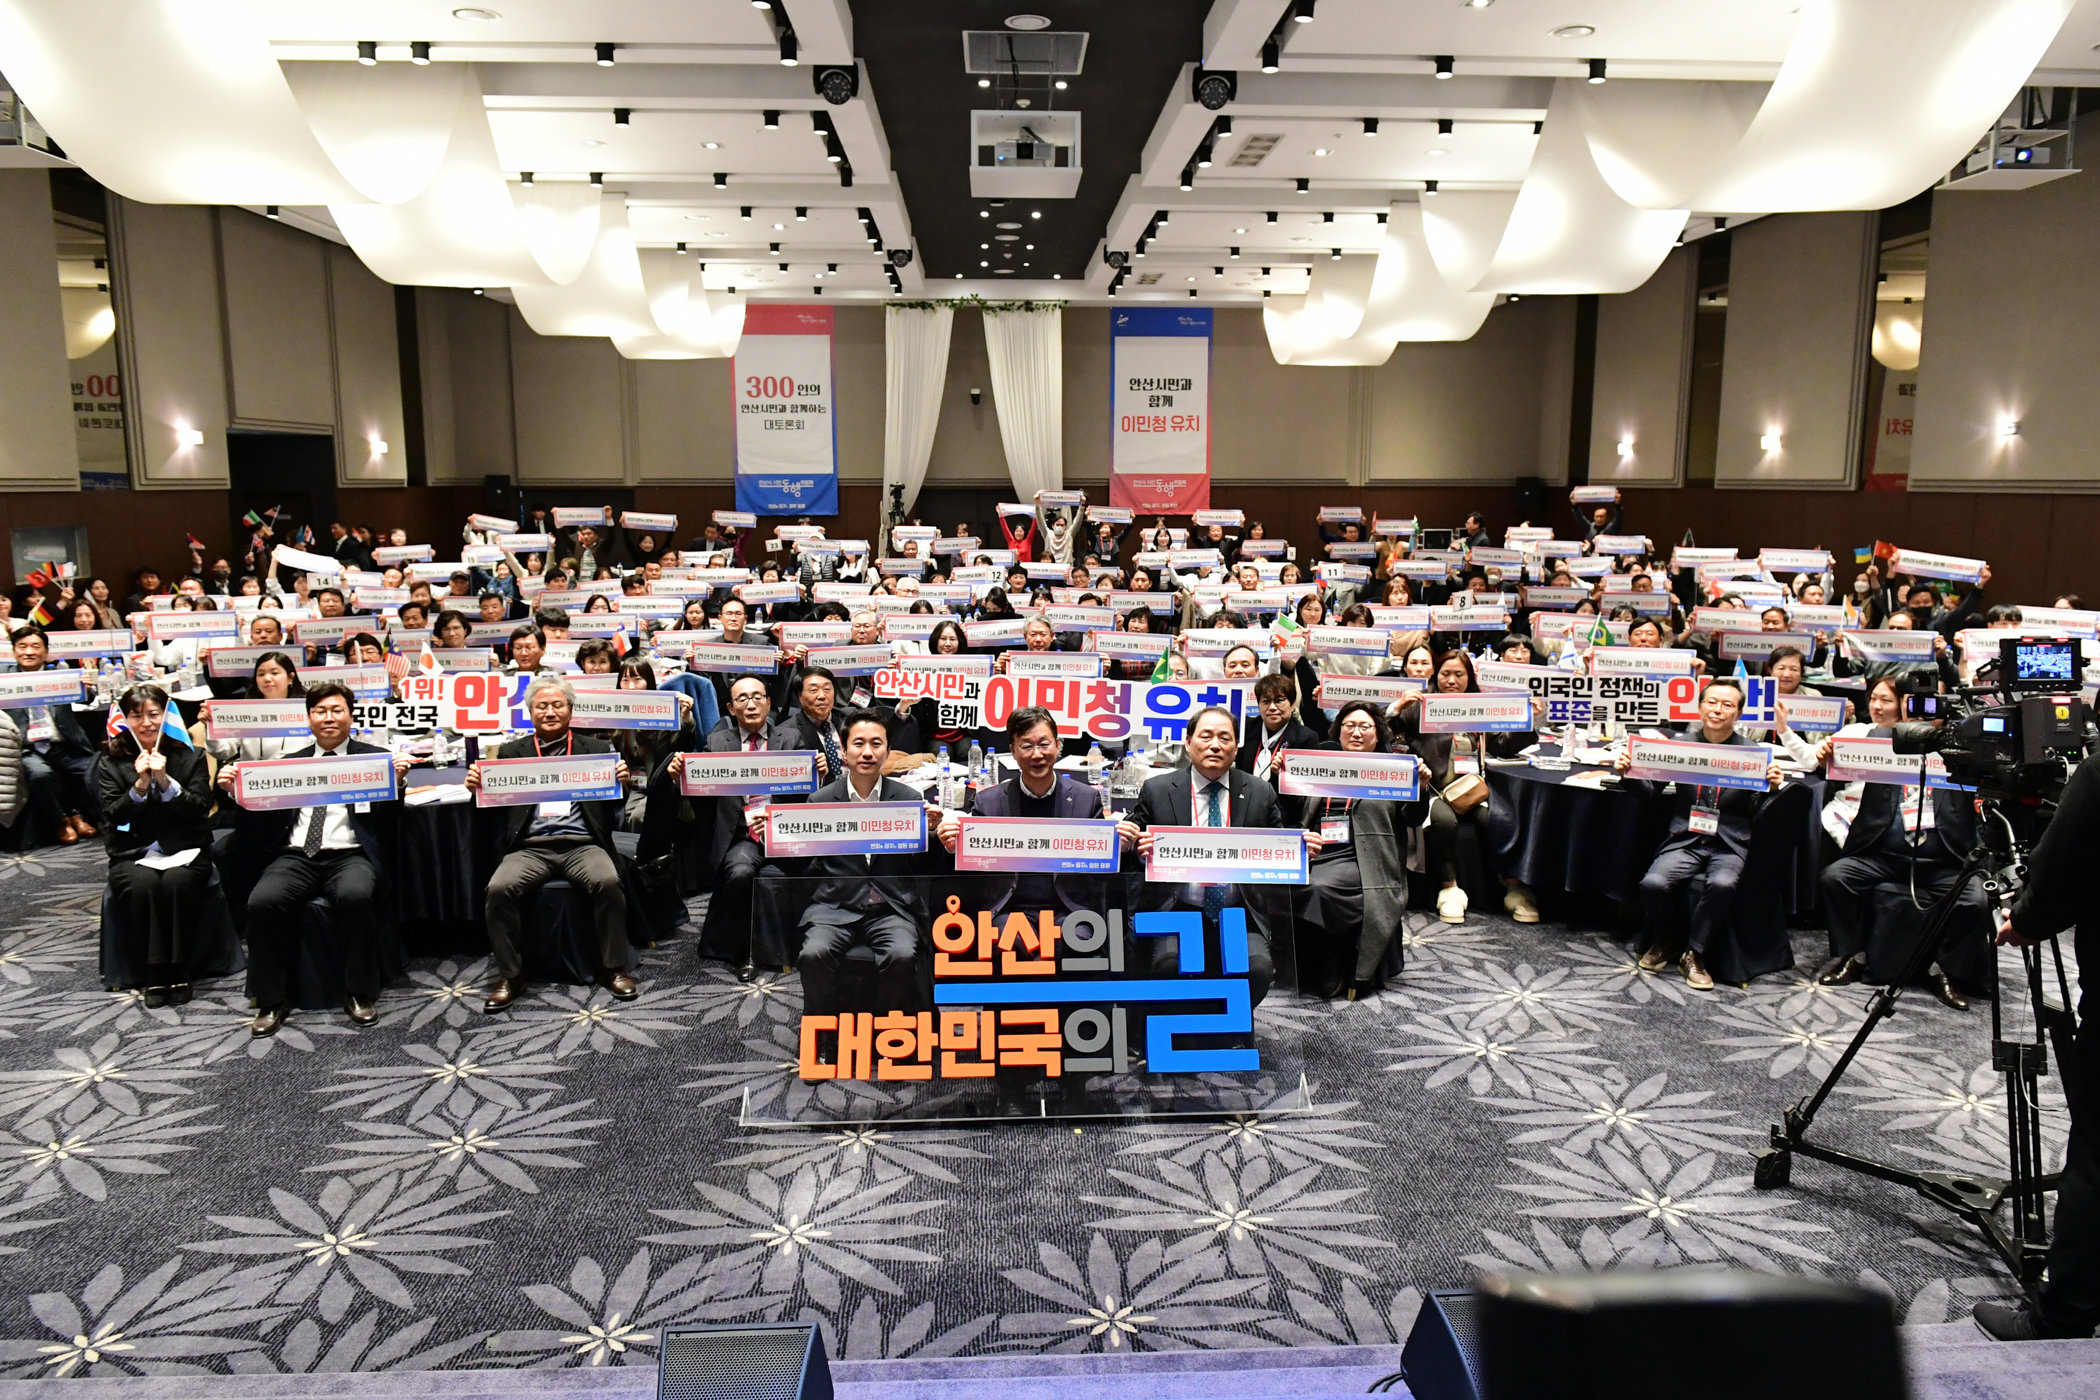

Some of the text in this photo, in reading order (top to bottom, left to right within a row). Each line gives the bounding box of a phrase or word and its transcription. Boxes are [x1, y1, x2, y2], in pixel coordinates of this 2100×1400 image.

[746, 376, 820, 398] 300 인의
[1129, 378, 1192, 391] 안산시민과
[1148, 394, 1173, 408] 함께
[741, 404, 826, 414] 안산시민과 함께하는
[764, 419, 804, 430] 대토론회
[1122, 415, 1200, 432] 이민청 유치
[316, 578, 329, 586] 14
[992, 571, 1001, 579] 12
[1460, 596, 1466, 608] 8
[401, 678, 444, 700] 1위!
[876, 671, 980, 700] 안산시민과
[1327, 687, 1362, 695] 안산시민과
[1381, 689, 1402, 697] 이민청
[1529, 677, 1660, 699] 외국인 정책의
[574, 704, 612, 712] 안산시민과
[633, 704, 654, 713] 이민청
[656, 705, 670, 713] 유치
[984, 677, 1132, 737] 이민청
[1549, 700, 1659, 722] 표준을 만든
[217, 712, 304, 723] 안산시민과 함께 이민청
[352, 706, 438, 728] 국인 전국
[940, 704, 978, 727] 함께
[1637, 752, 1761, 773] 안산시민과 함께 이민청 유치
[488, 771, 611, 787] 안산시민과 함께 이민청 유치
[691, 766, 807, 778] 안산시민과 함께 이민청 유치
[1291, 767, 1408, 781] 안산시민과 함께 이민청 유치
[249, 771, 384, 790] 안산시민과 함께 이민청 유치
[779, 820, 914, 833] 안산시민과 함께 이민청 유치
[970, 837, 1107, 851] 안산시민과 함께 이민청 유치
[1160, 847, 1295, 860] 안산시민과 함께 이민청 유치
[932, 895, 1124, 977] 안산의
[799, 1006, 1128, 1080] 대한민국의
